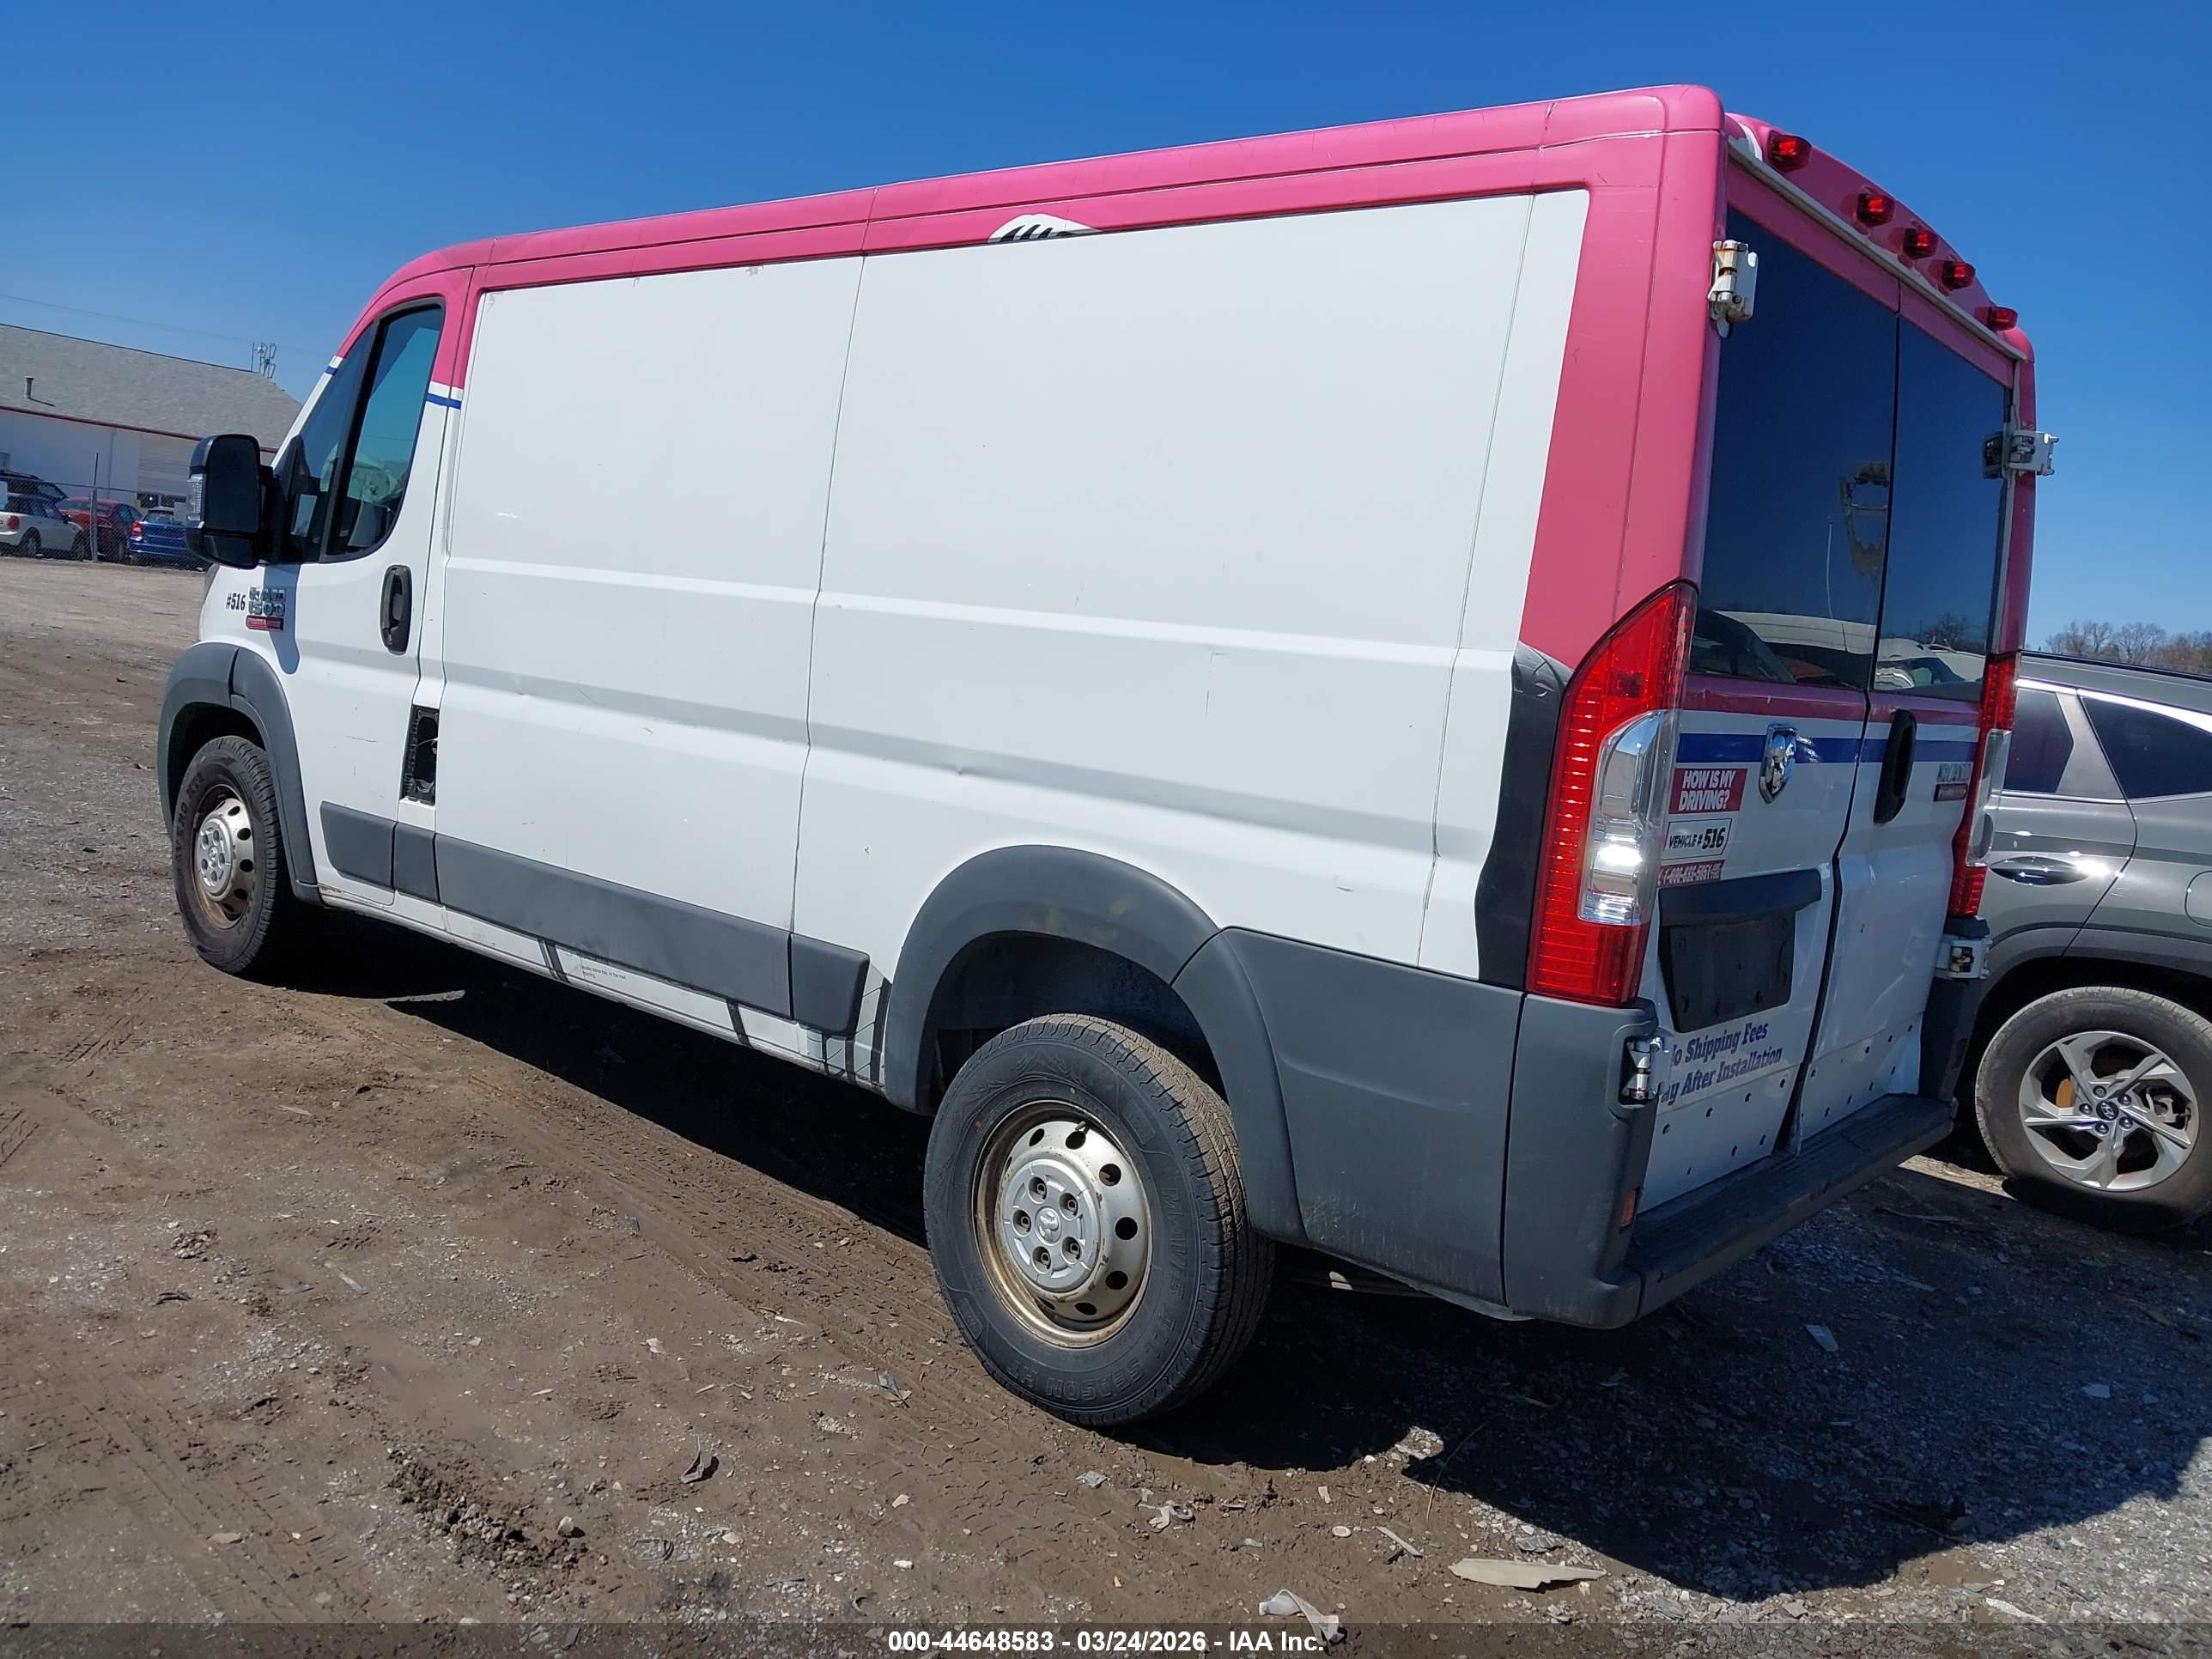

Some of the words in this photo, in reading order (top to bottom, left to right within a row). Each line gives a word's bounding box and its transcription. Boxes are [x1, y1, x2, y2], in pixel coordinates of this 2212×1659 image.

[226, 592, 246, 611] #516
[1682, 770, 1710, 789] HOW
[1709, 771, 1721, 789] IS
[1719, 770, 1736, 788] MY
[1678, 789, 1730, 811] DRIVING?
[1668, 834, 1698, 849] VEHICLE
[1702, 827, 1726, 849] 516
[1685, 1030, 1741, 1063] Shipping
[1741, 1022, 1769, 1045] Fees
[1680, 1069, 1717, 1096] After
[1717, 1046, 1783, 1084] Installation
